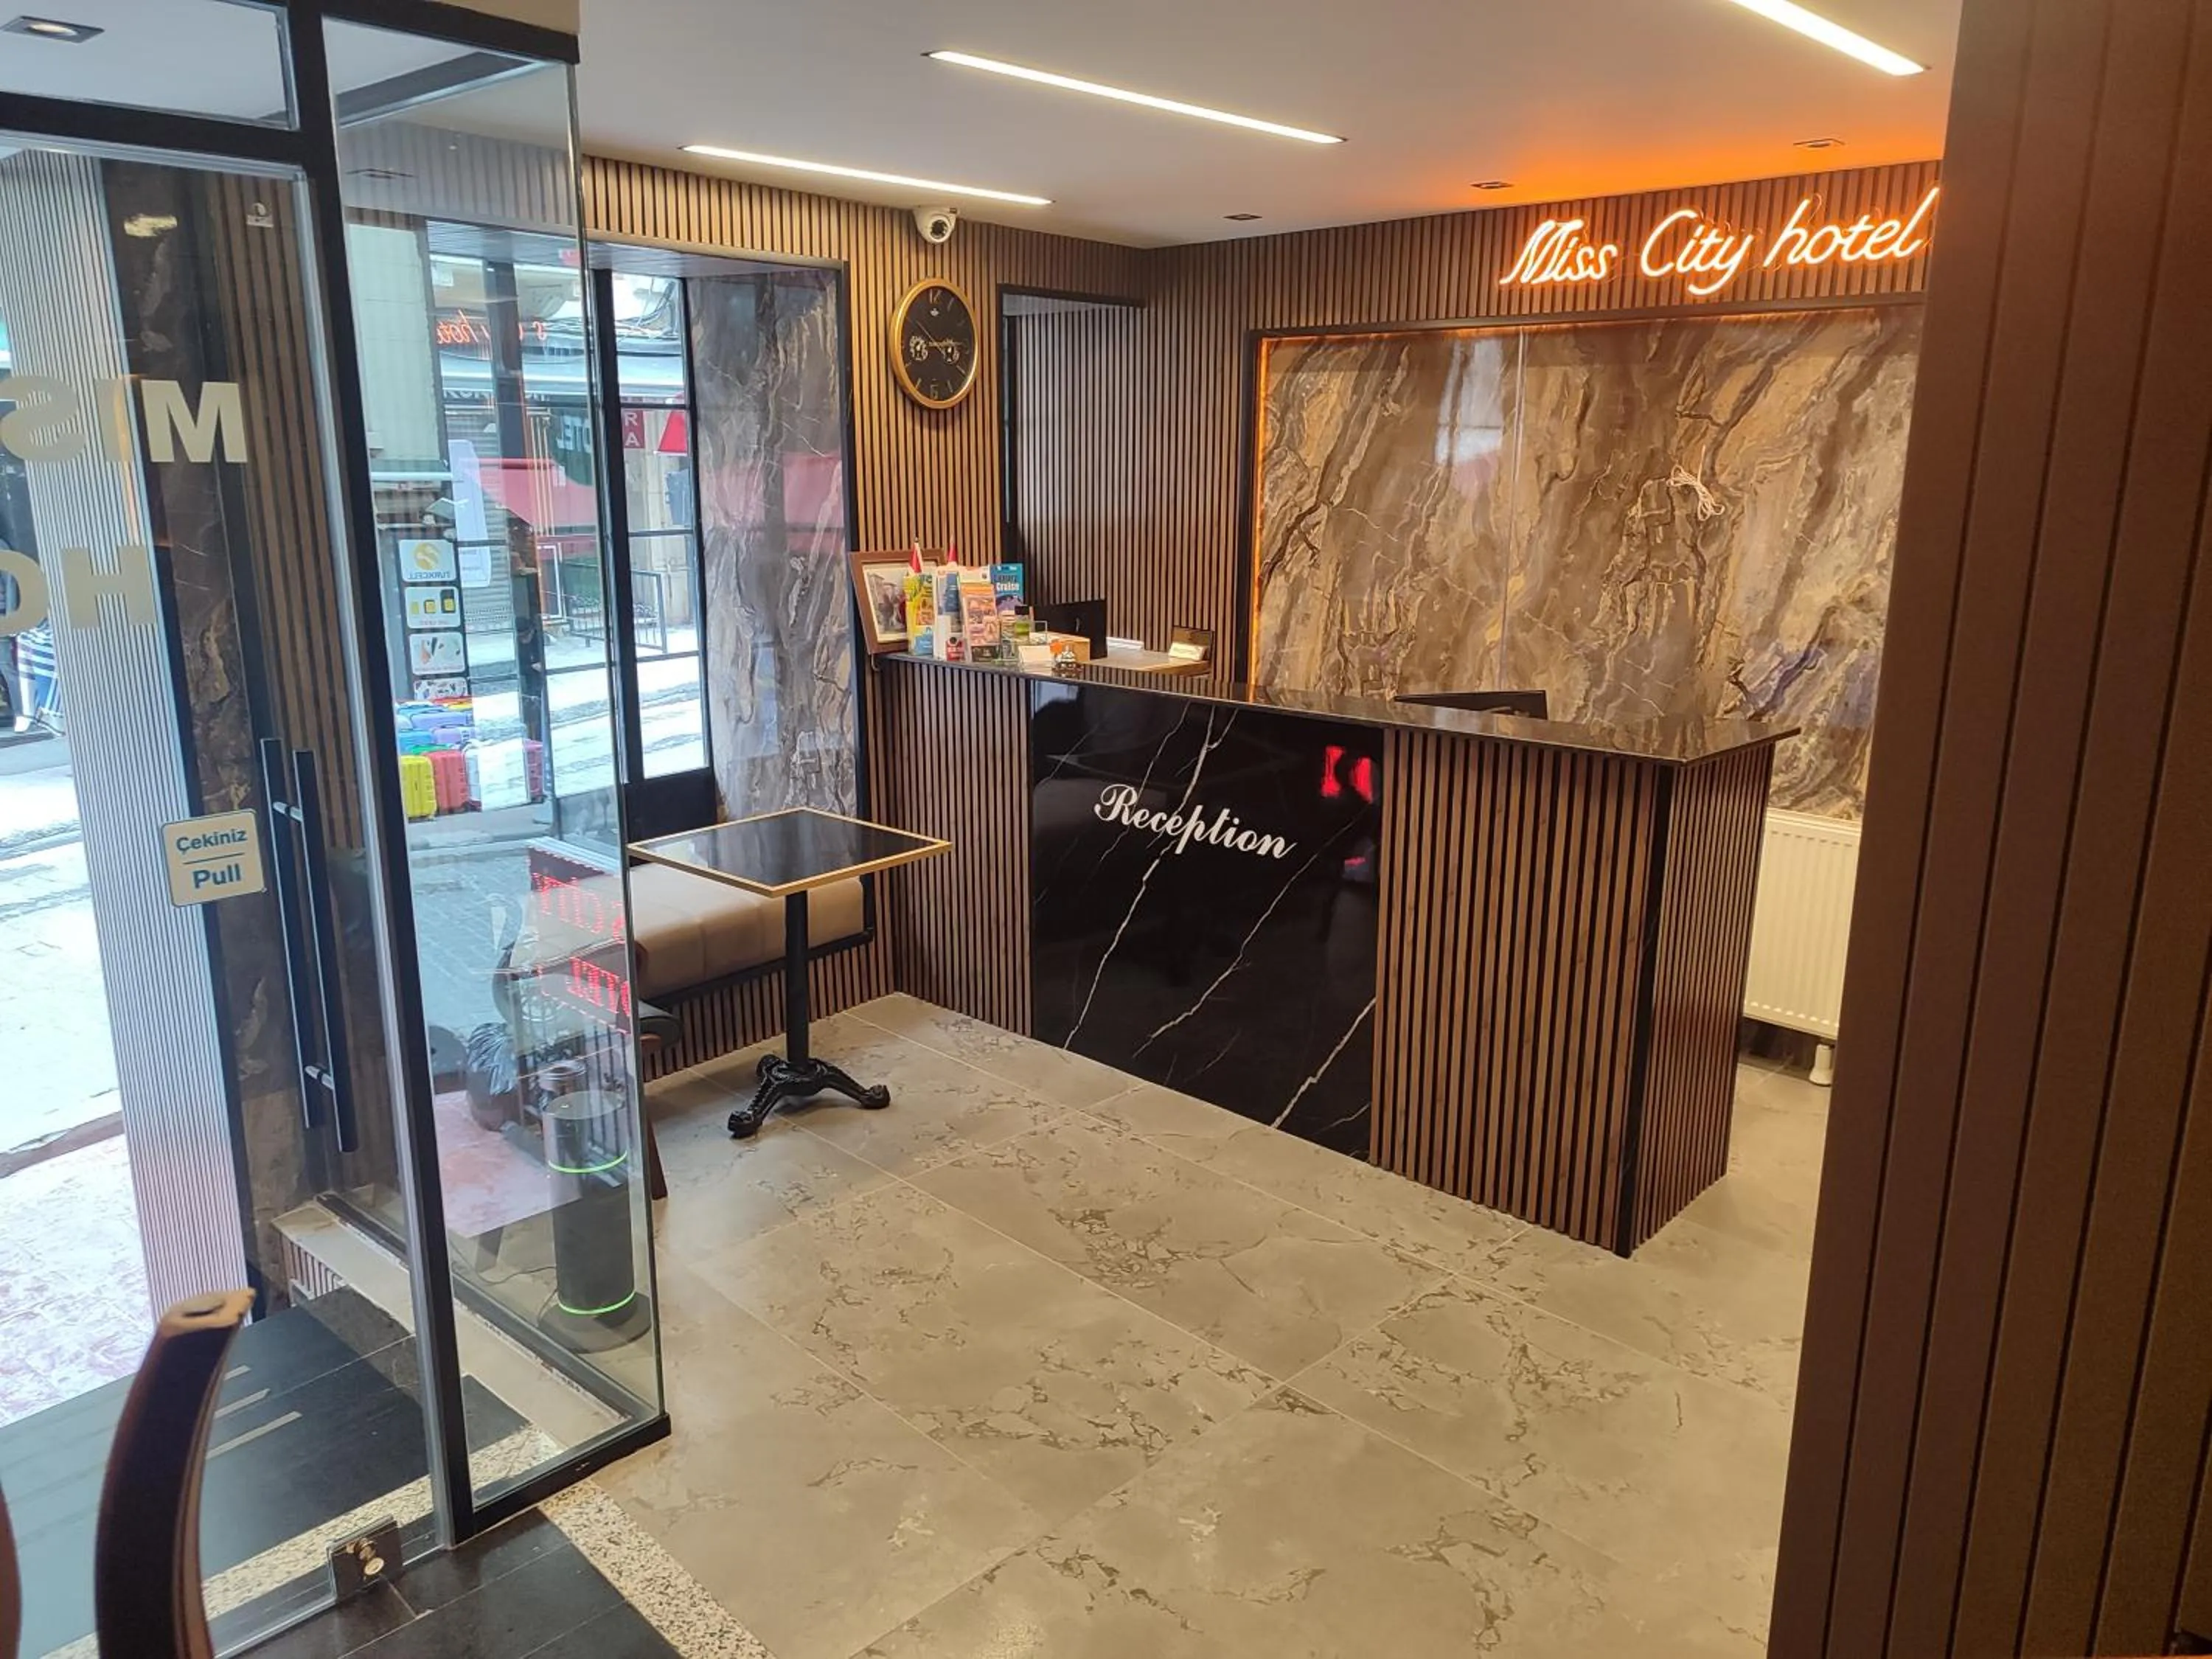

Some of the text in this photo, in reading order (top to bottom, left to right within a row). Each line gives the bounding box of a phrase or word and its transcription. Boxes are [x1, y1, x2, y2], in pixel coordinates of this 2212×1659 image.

[1500, 187, 1941, 295] Miss City hotel
[175, 829, 248, 856] Çekiniz
[1093, 784, 1298, 860] Reception
[192, 863, 242, 889] Pull
